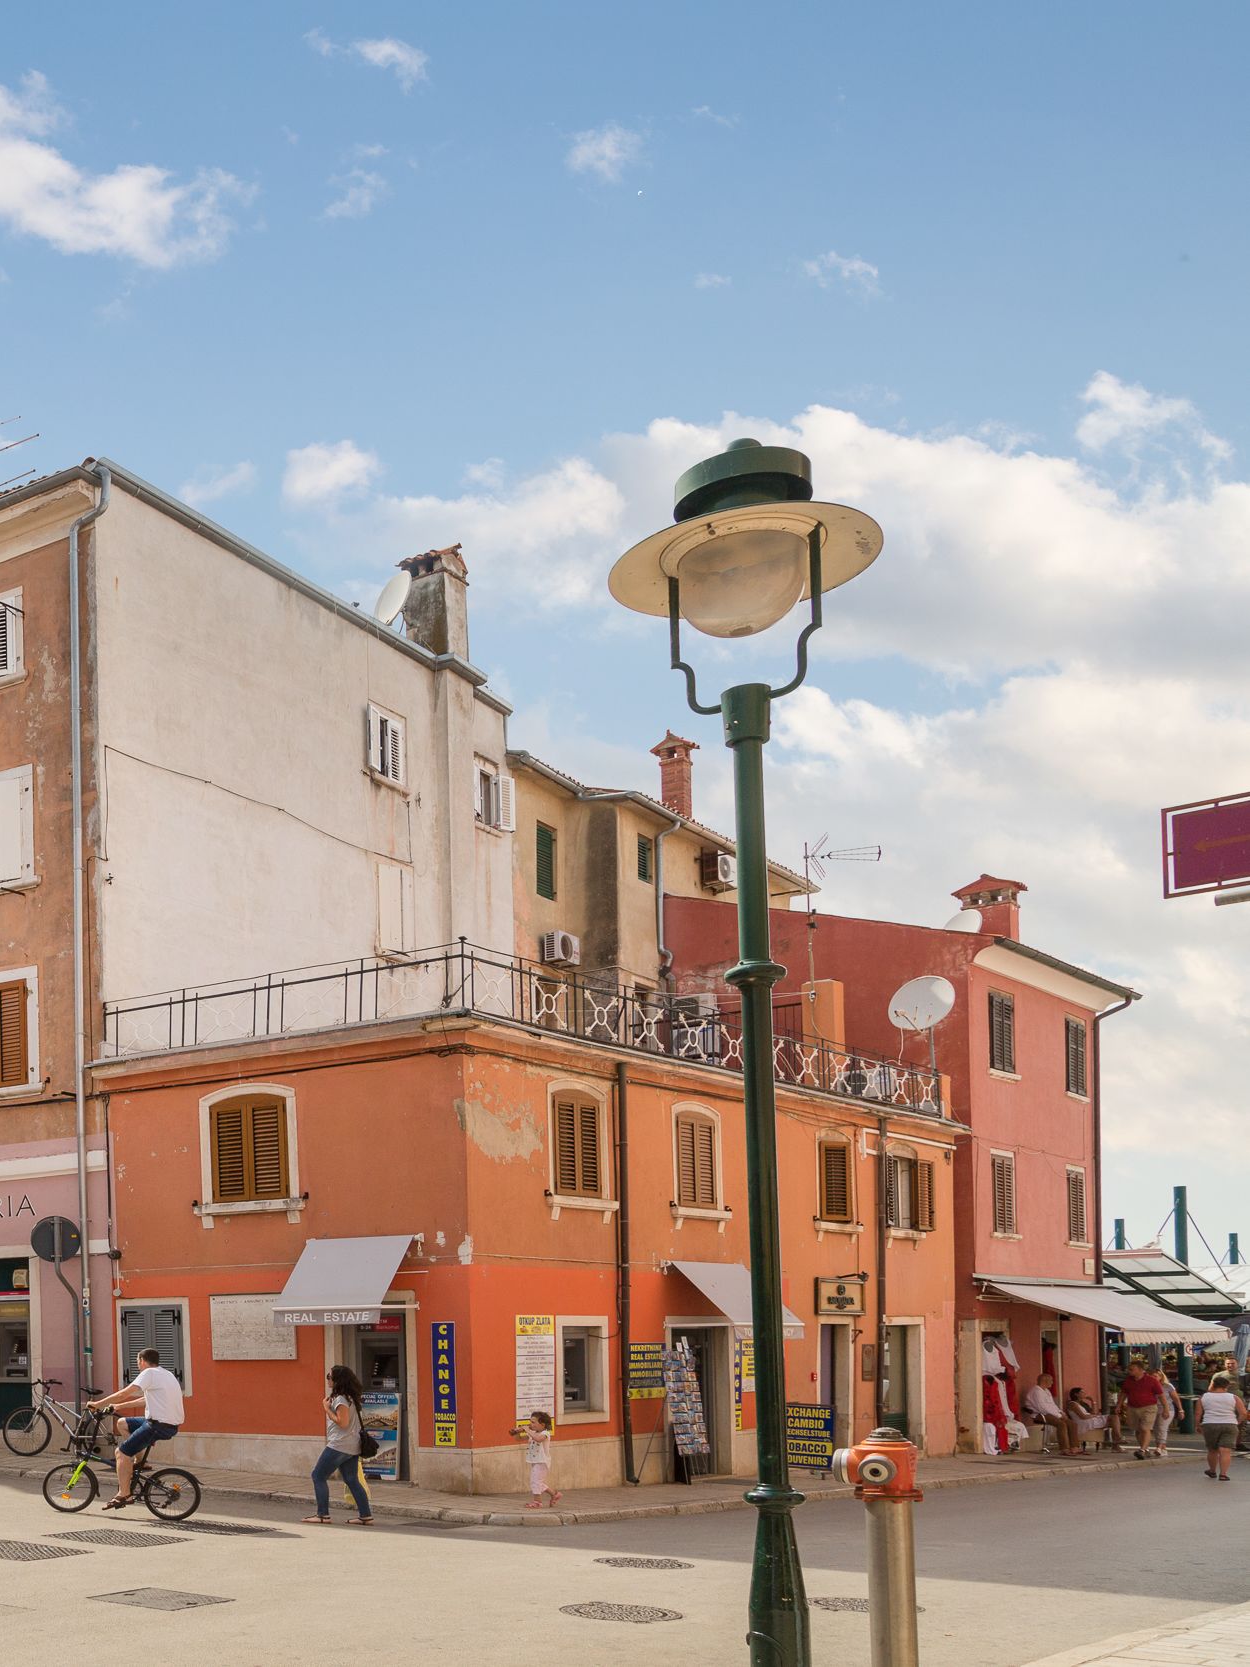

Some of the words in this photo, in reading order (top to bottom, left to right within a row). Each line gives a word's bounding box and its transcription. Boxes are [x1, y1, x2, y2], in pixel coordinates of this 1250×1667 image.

[284, 1312, 317, 1323] REAL
[323, 1311, 370, 1323] ESTATE
[518, 1316, 535, 1326] OTKUP
[536, 1316, 551, 1325] ZLATA
[437, 1324, 450, 1409] CHANGE
[435, 1413, 456, 1421] TOBACCO
[787, 1407, 831, 1419] XCHANGE
[787, 1418, 824, 1429] CAMBIO
[787, 1429, 831, 1438] ECHSELSTUBE
[788, 1442, 827, 1454] OBACCO
[787, 1454, 828, 1466] OUVENIRS
